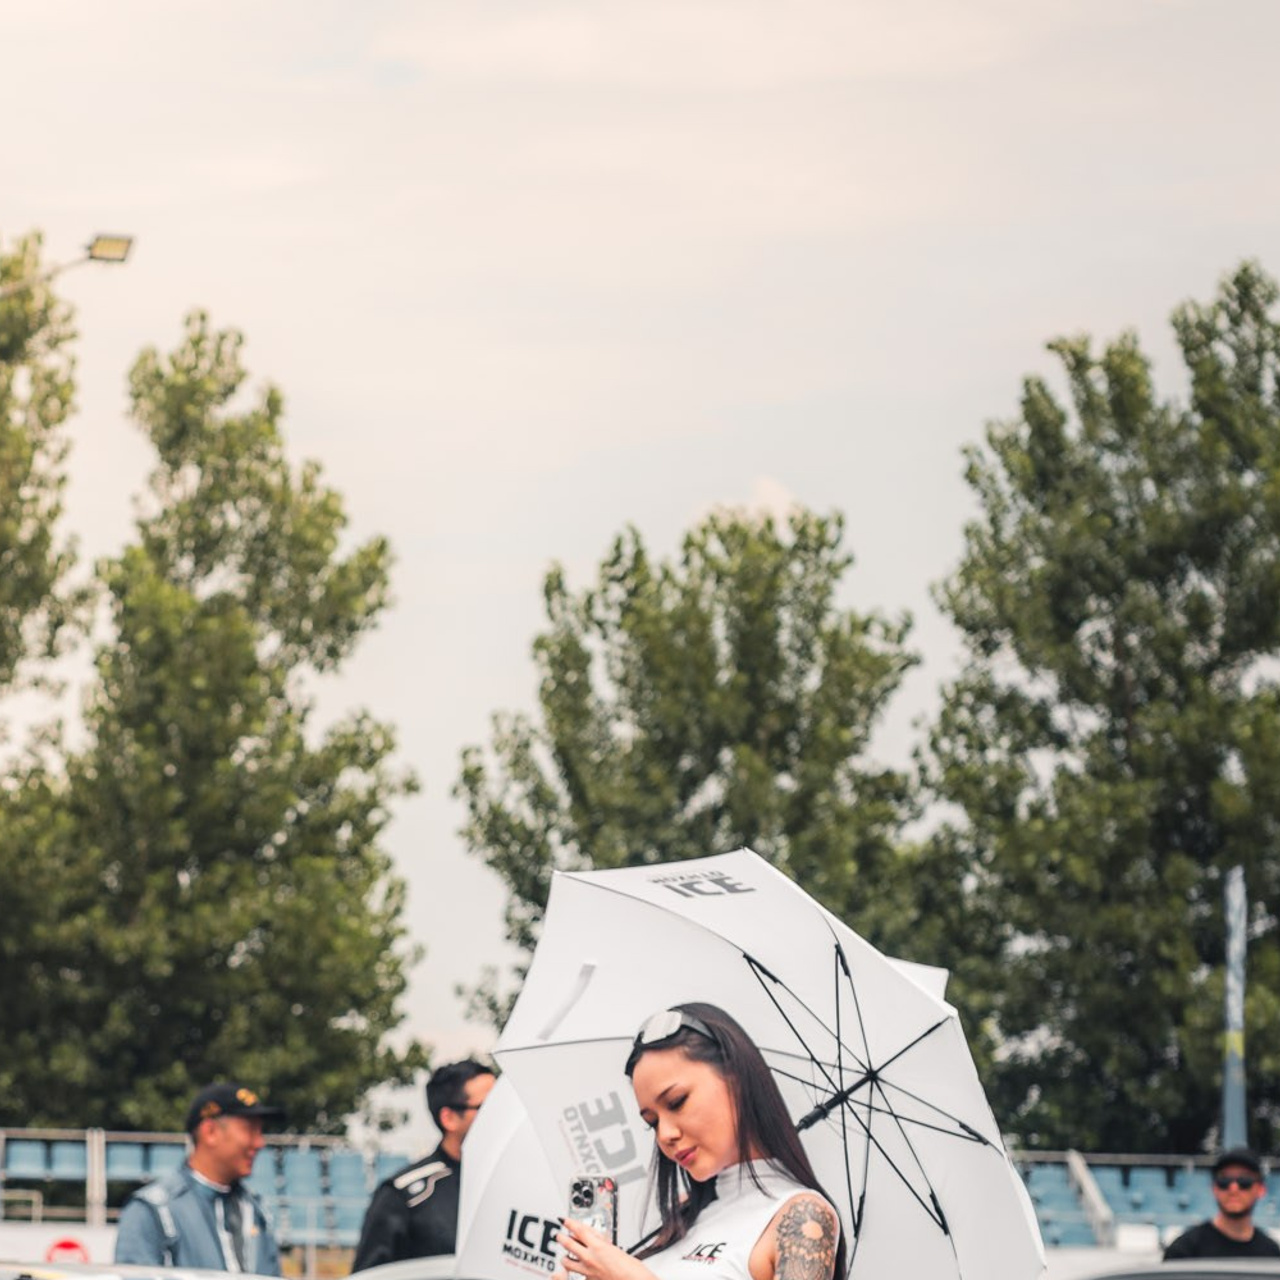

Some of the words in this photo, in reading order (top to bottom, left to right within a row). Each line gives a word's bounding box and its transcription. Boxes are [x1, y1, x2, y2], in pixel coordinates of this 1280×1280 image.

[663, 876, 757, 898] ICE
[506, 1209, 562, 1258] ICE
[503, 1243, 556, 1272] МОХИТО
